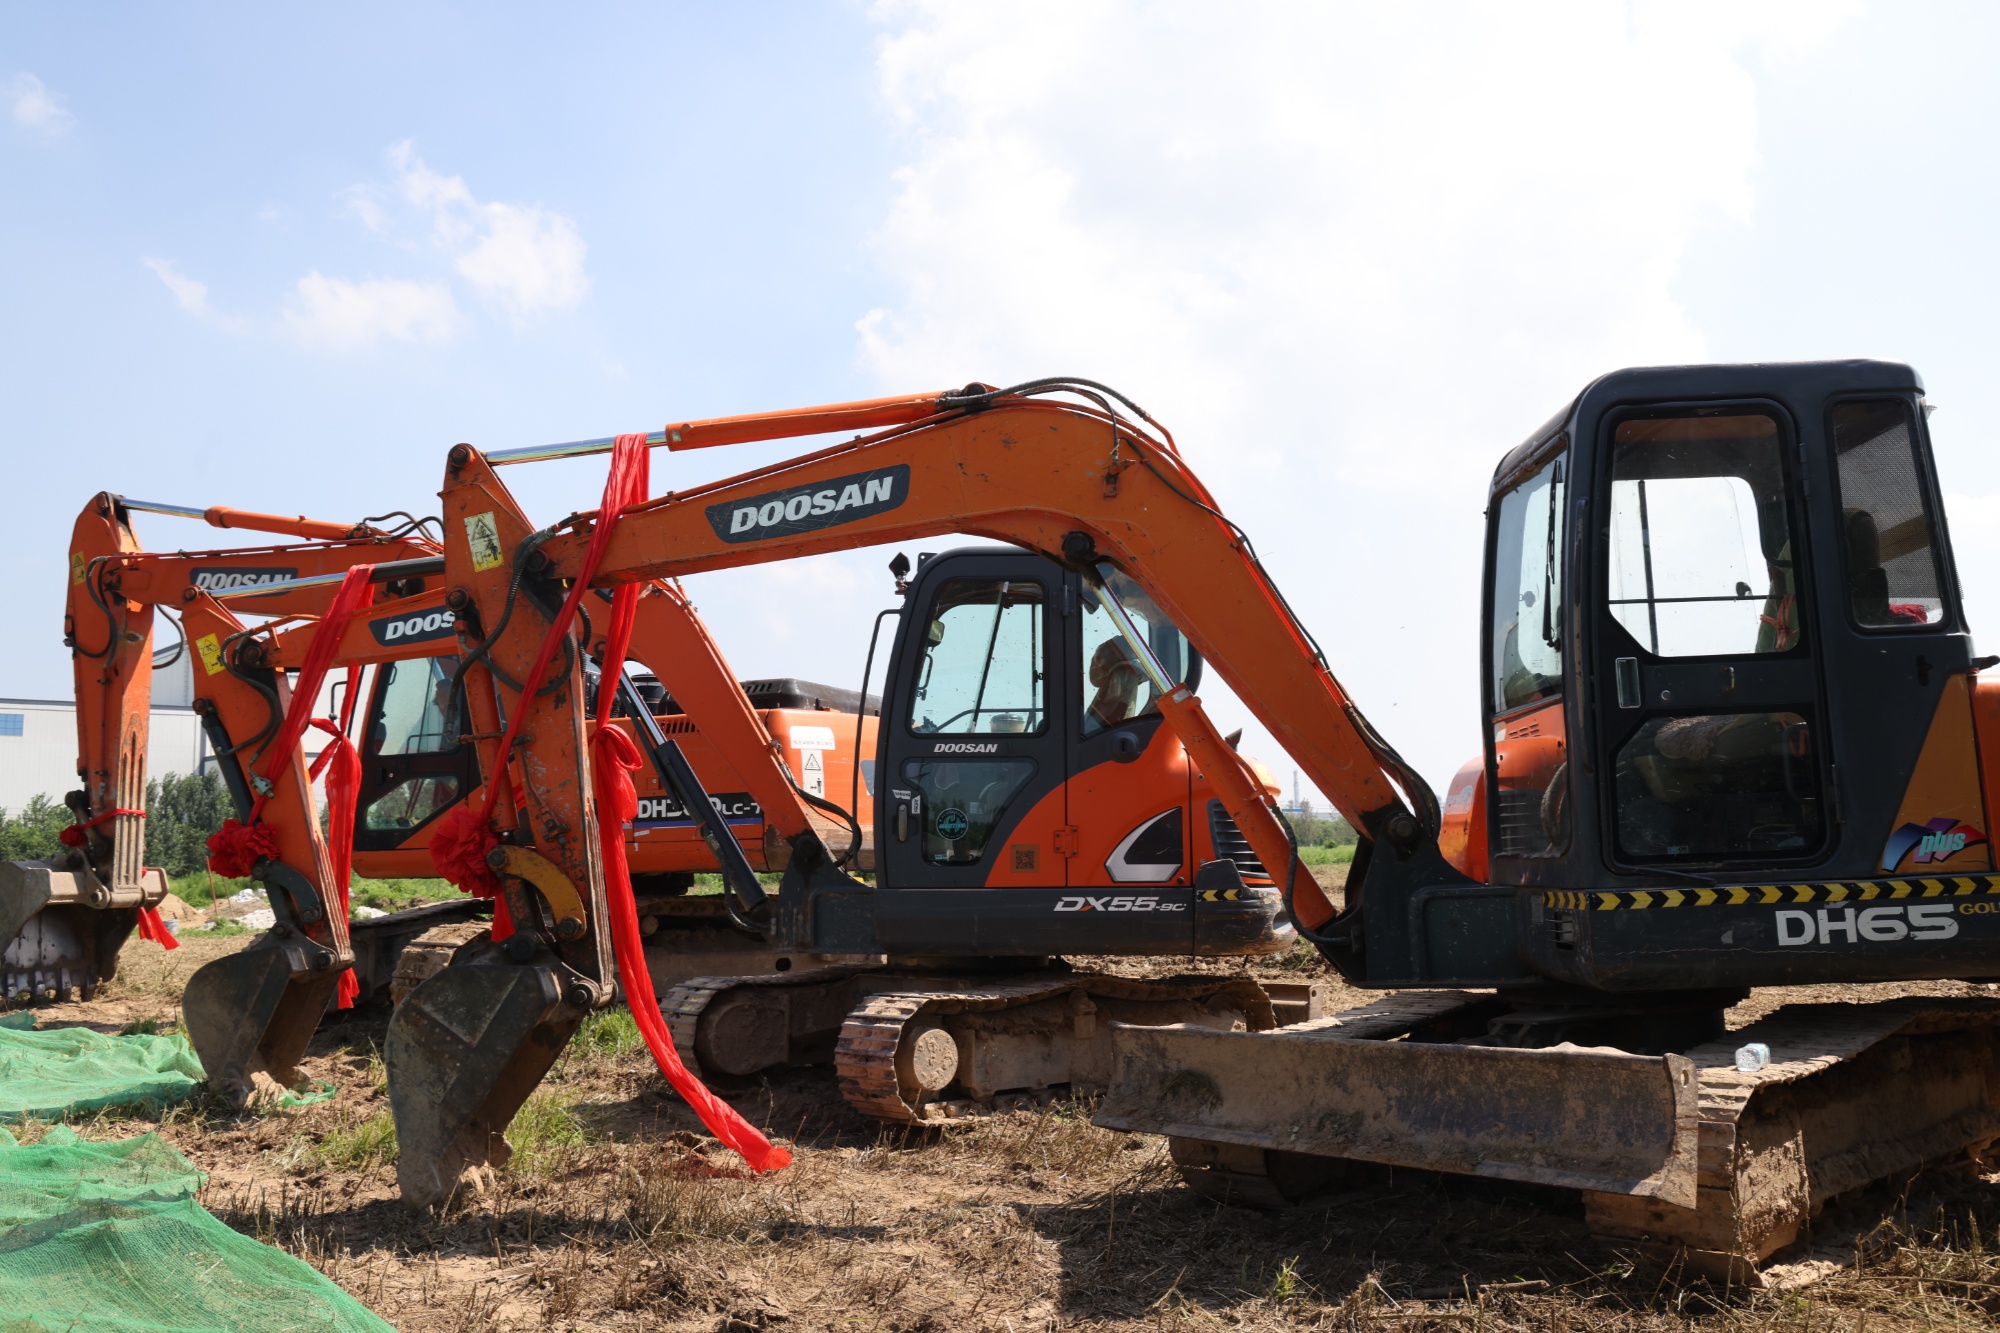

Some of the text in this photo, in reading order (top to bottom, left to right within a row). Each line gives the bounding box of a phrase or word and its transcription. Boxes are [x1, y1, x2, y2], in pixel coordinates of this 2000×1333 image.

[730, 476, 894, 535] DOOSAN
[933, 743, 998, 753] DOOSAN
[1918, 830, 1967, 857] plus
[1775, 902, 2000, 946] DH65 GOL
